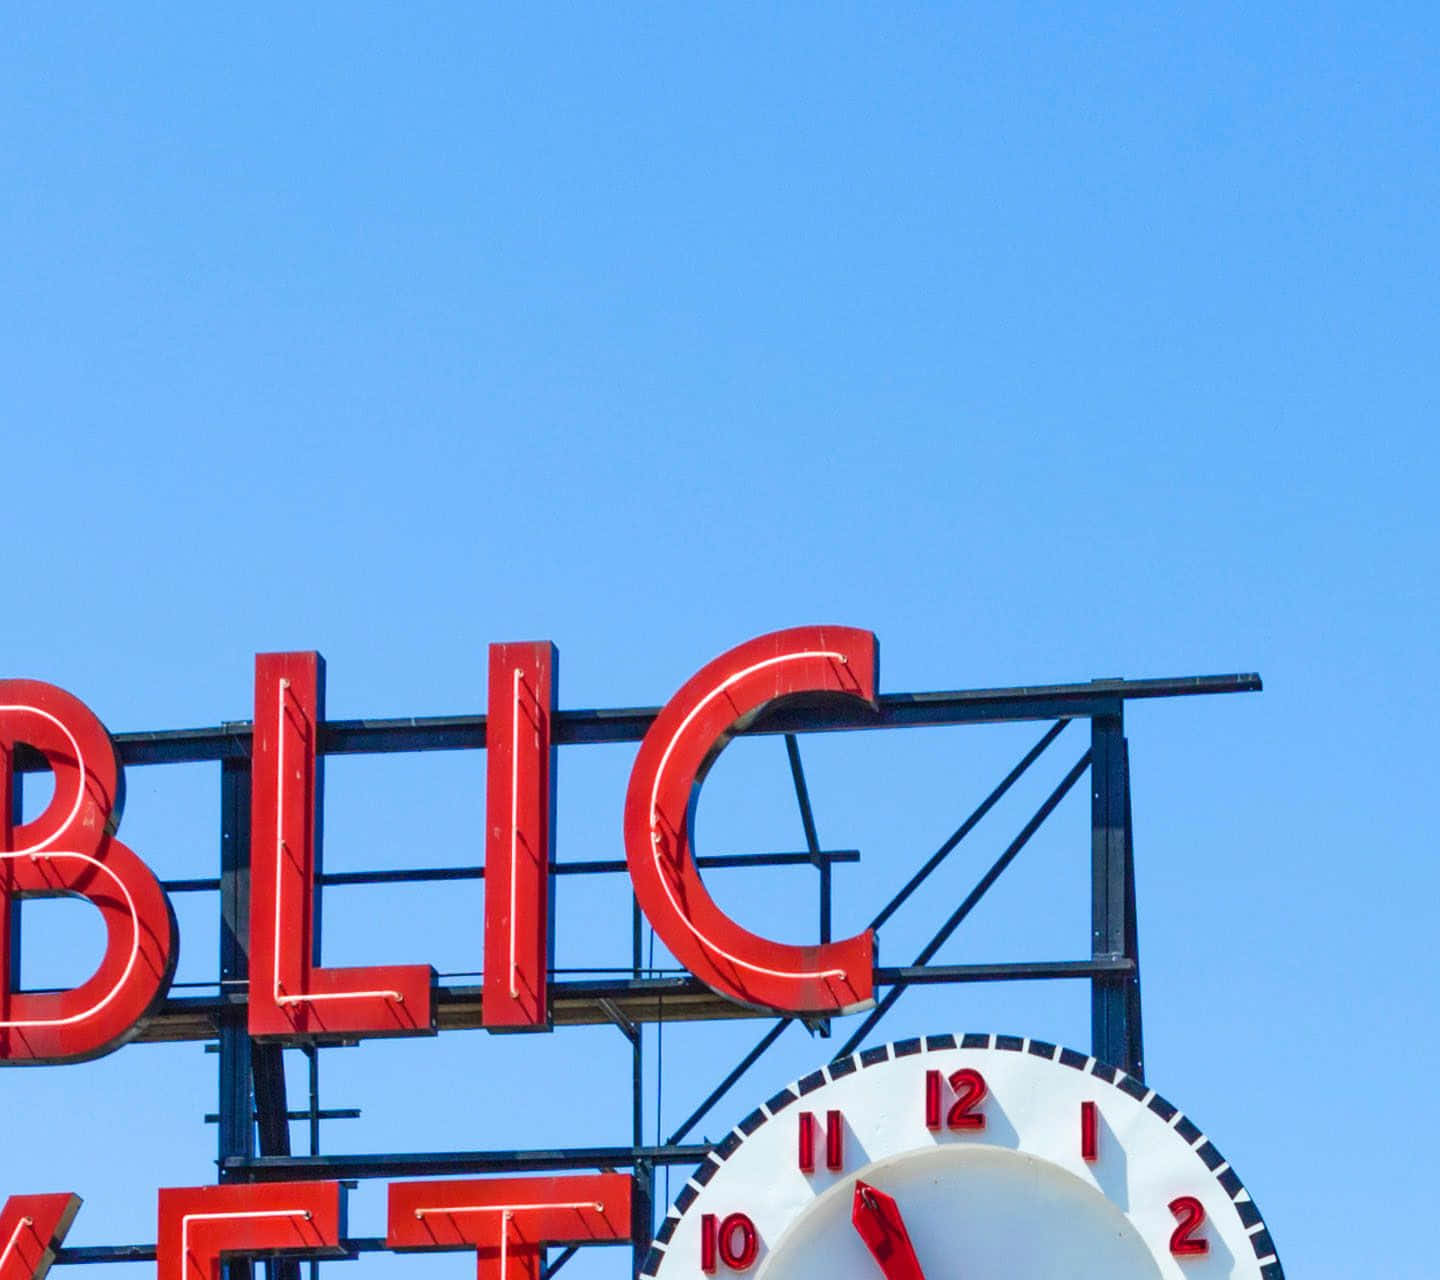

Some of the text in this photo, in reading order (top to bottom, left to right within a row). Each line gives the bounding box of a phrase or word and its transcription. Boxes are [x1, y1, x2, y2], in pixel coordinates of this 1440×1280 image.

[925, 1067, 988, 1131] 12
[1081, 1100, 1098, 1161] 1
[798, 1109, 845, 1172] 11
[700, 1211, 761, 1275] 10
[1167, 1196, 1210, 1256] 2
